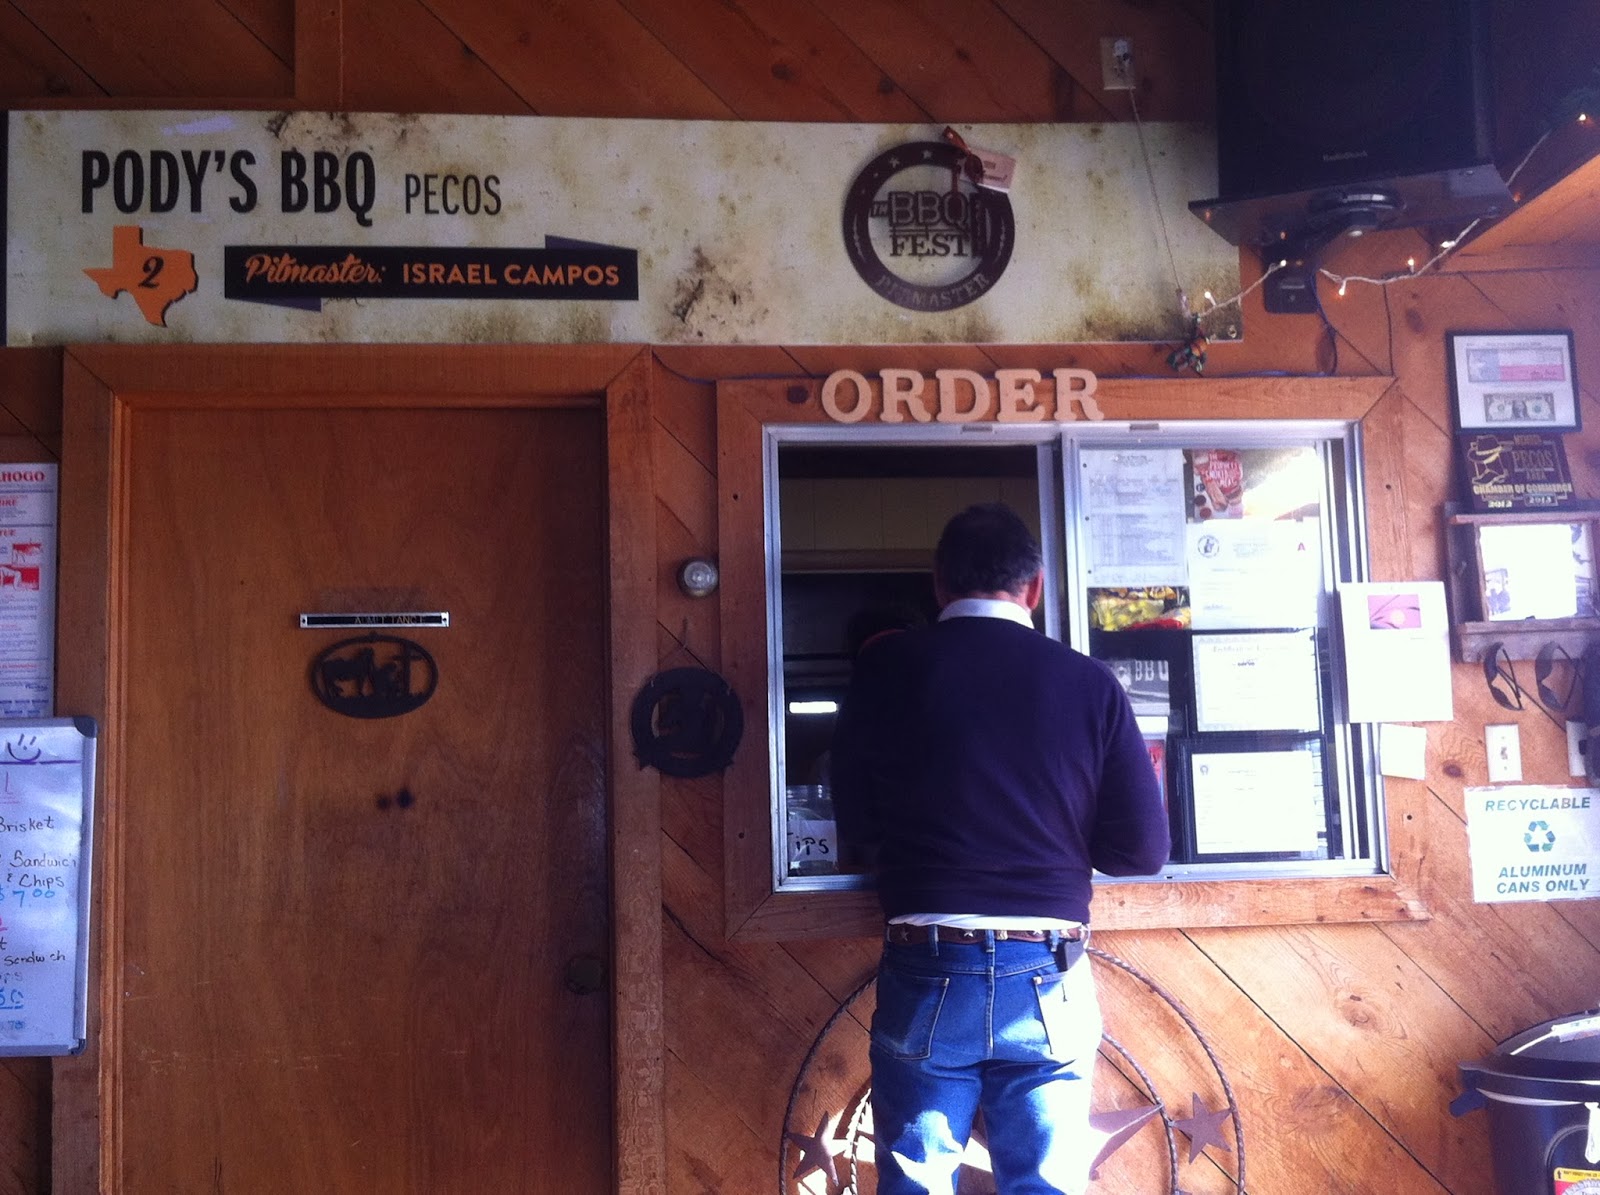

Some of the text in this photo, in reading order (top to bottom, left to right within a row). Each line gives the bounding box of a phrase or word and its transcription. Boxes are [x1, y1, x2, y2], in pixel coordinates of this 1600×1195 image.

[81, 150, 502, 227] PODY'S BBQ PECOS
[888, 191, 970, 231] BBQ
[889, 234, 969, 257] FEST
[138, 256, 164, 288] 2
[245, 253, 620, 286] Pitmaster: ISRAEL CAMPOS
[821, 368, 1105, 424] ORDER
[1485, 797, 1590, 811] RECYCLABLE
[0, 816, 54, 832] Brisket
[787, 832, 829, 855] iPS
[19, 874, 64, 889] Chips
[1498, 863, 1587, 878] ALUMINUM
[1496, 879, 1590, 894] CANS ONLY
[4, 950, 65, 966] Sandwch
